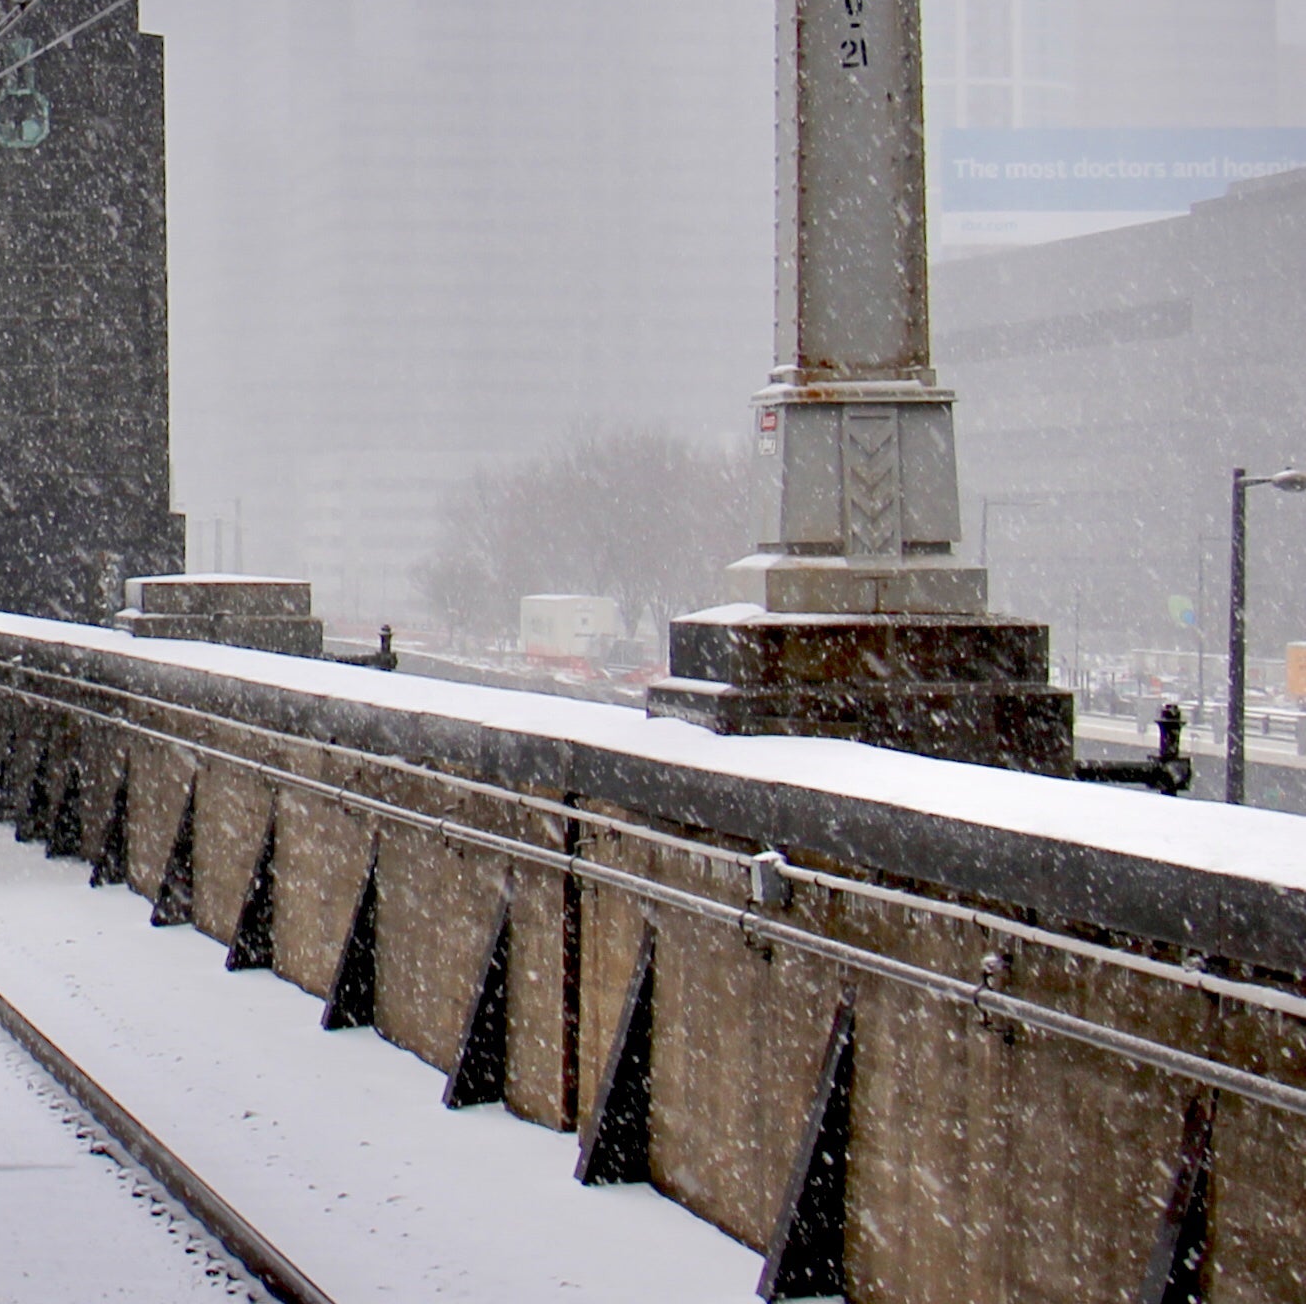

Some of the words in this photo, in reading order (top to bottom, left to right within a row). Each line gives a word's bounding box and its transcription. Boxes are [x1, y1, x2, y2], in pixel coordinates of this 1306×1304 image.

[952, 157, 999, 179] The
[1005, 159, 1067, 179] most
[1073, 157, 1167, 179] doctors
[1172, 156, 1217, 179] and
